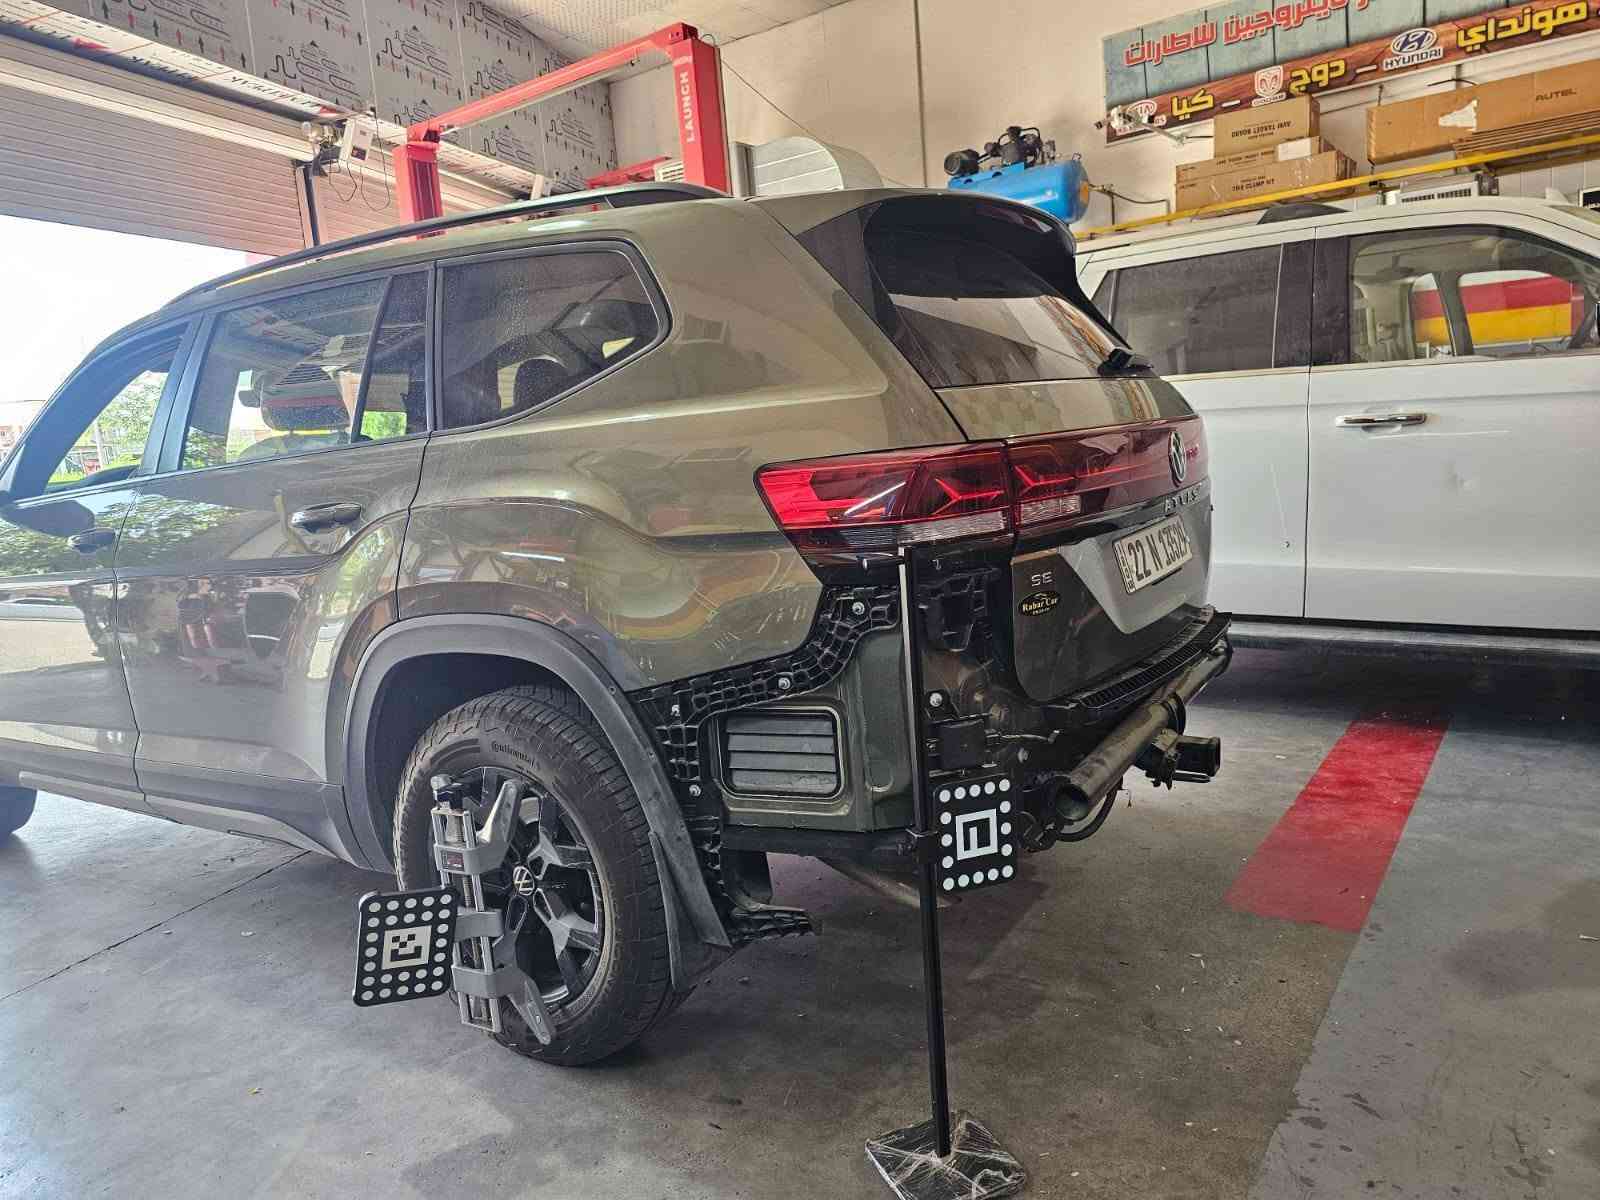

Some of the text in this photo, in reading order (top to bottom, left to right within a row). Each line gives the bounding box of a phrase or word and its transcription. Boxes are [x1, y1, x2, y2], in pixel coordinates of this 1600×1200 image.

[1170, 1, 1588, 120] هونداي دوج كيا
[1384, 48, 1442, 70] HYUNDAI
[680, 71, 695, 143] LAUNCH
[1535, 87, 1577, 102] AUTEL
[1128, 540, 1151, 581] 22
[1145, 533, 1163, 571] N
[1031, 571, 1053, 587] SE
